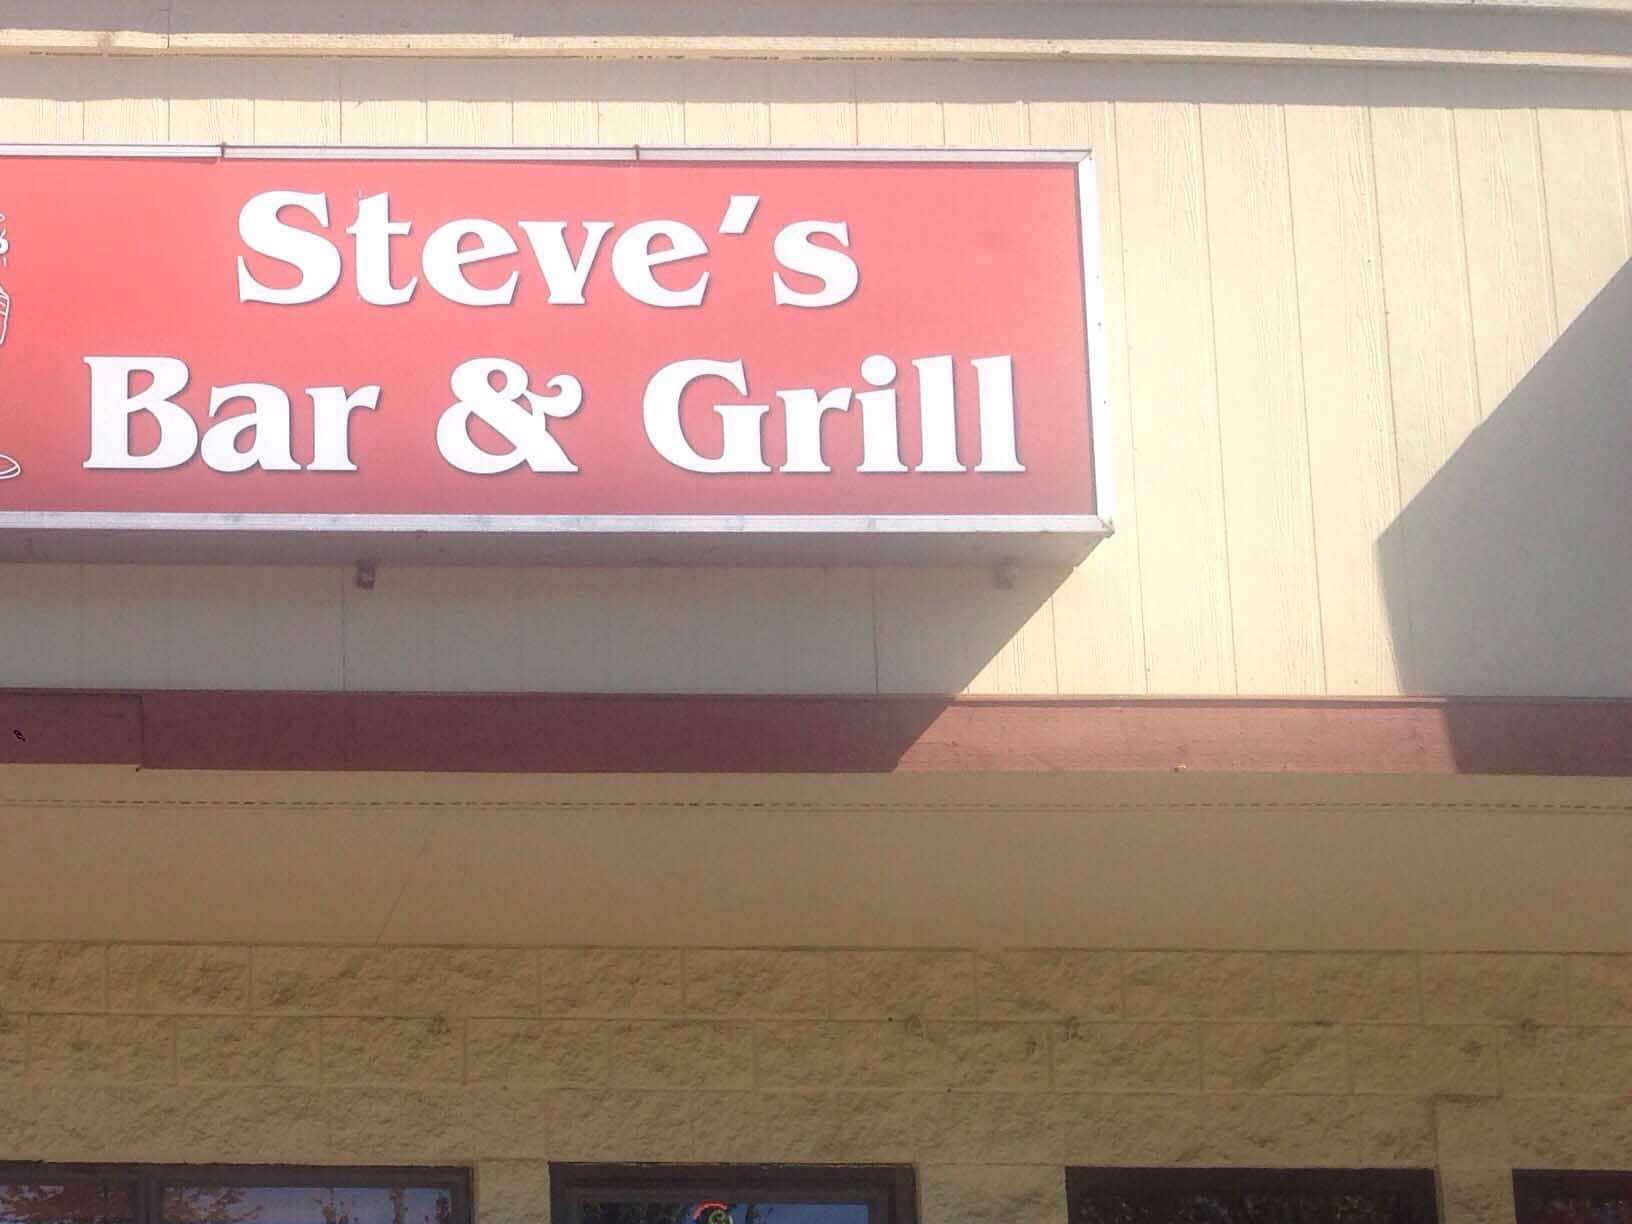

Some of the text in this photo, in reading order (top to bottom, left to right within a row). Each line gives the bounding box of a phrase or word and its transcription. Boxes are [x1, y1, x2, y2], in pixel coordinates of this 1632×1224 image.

[234, 189, 860, 308] Steve's
[82, 352, 1025, 475] Bar & Grill
